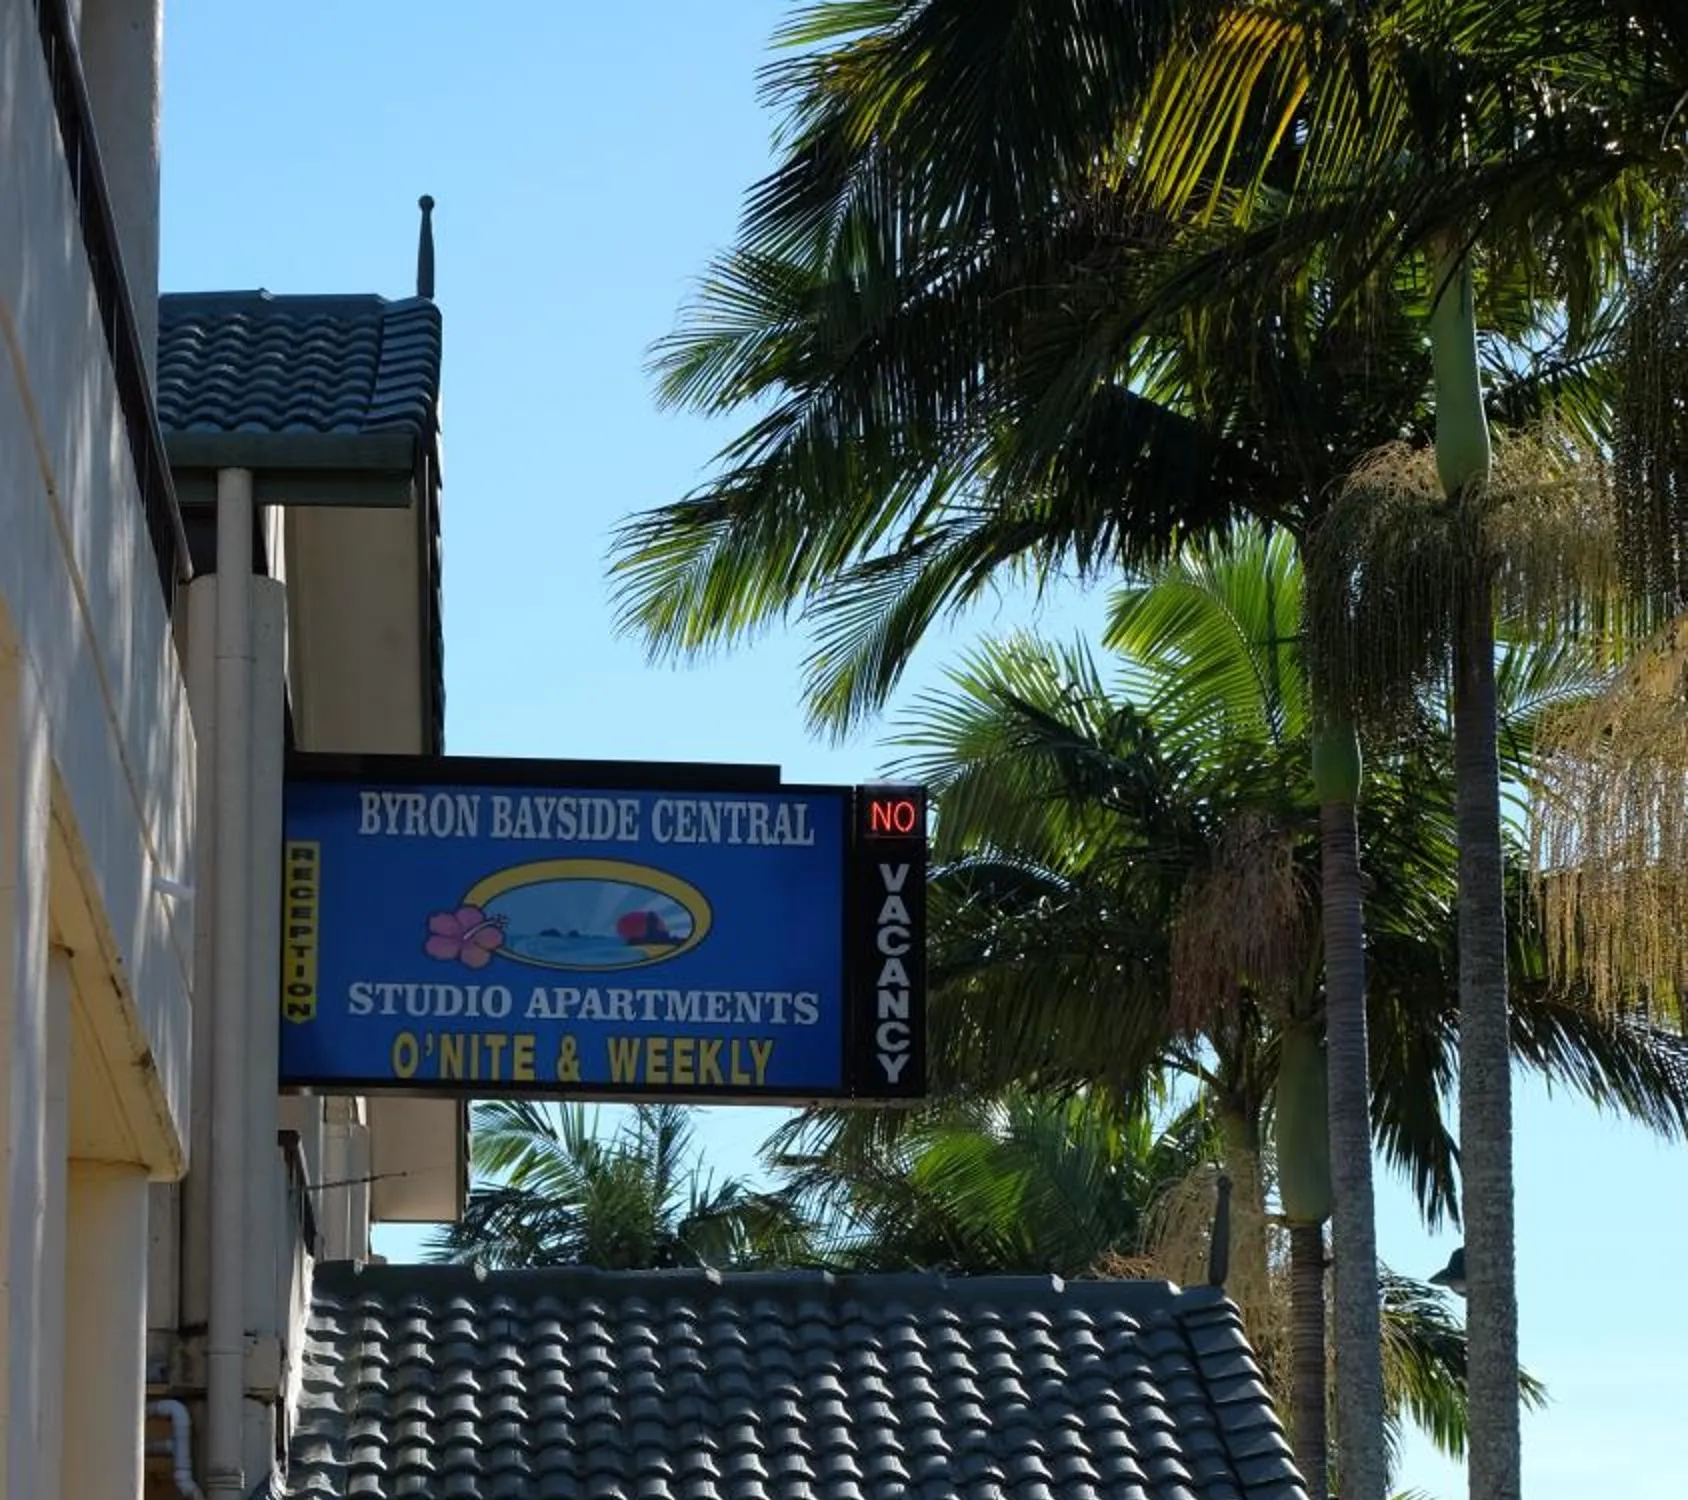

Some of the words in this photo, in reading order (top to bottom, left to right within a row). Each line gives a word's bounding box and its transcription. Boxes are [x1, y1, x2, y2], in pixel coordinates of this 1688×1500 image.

[359, 791, 480, 838] BYRON
[490, 795, 639, 842] BAYSIDE
[652, 800, 815, 846] CENTRAL
[870, 801, 915, 833] NO
[287, 847, 315, 1017] RECEPTION
[876, 863, 912, 1083] VACANCY
[348, 982, 512, 1018] STUDIO
[525, 987, 820, 1025] APARTMENTS
[391, 1031, 536, 1082] O'NITE
[556, 1035, 581, 1083] &
[608, 1037, 774, 1086] WEEKLY
